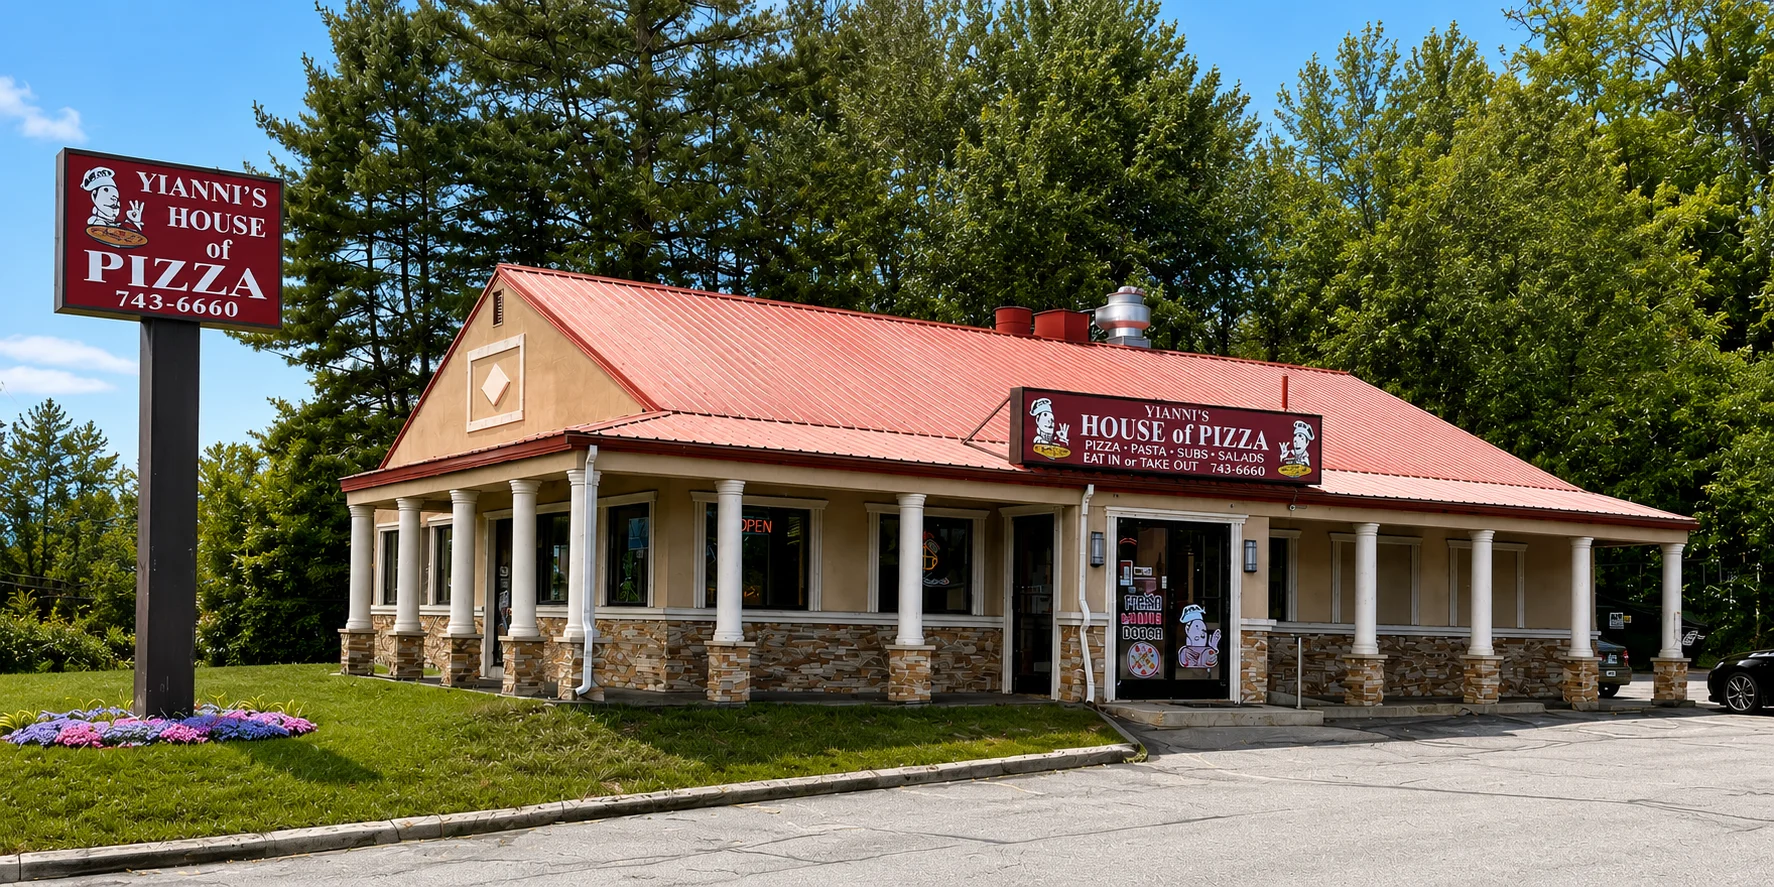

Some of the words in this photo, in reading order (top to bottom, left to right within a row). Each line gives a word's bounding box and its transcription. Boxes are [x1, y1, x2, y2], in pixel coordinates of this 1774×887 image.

[136, 171, 267, 208] YIANNI'S
[167, 206, 266, 238] HOUSE
[206, 239, 233, 260] of
[83, 249, 267, 300] PIZZA
[115, 290, 239, 318] 743-6660
[1144, 405, 1210, 422] YIANNI'S
[1080, 414, 1165, 443] HOUSE
[1172, 423, 1194, 445] of
[1198, 424, 1269, 451] PIZZA
[1083, 452, 1105, 464] EAT
[1107, 454, 1121, 466] IN
[1124, 457, 1138, 467] or
[1139, 457, 1170, 470] TAKE
[1173, 460, 1199, 472] OUT
[1210, 462, 1266, 477] 743-6660
[1085, 440, 1121, 452] PIZZA
[1131, 444, 1167, 457] PASTA
[1177, 448, 1209, 460] SUBS
[1218, 450, 1265, 464] SALADS
